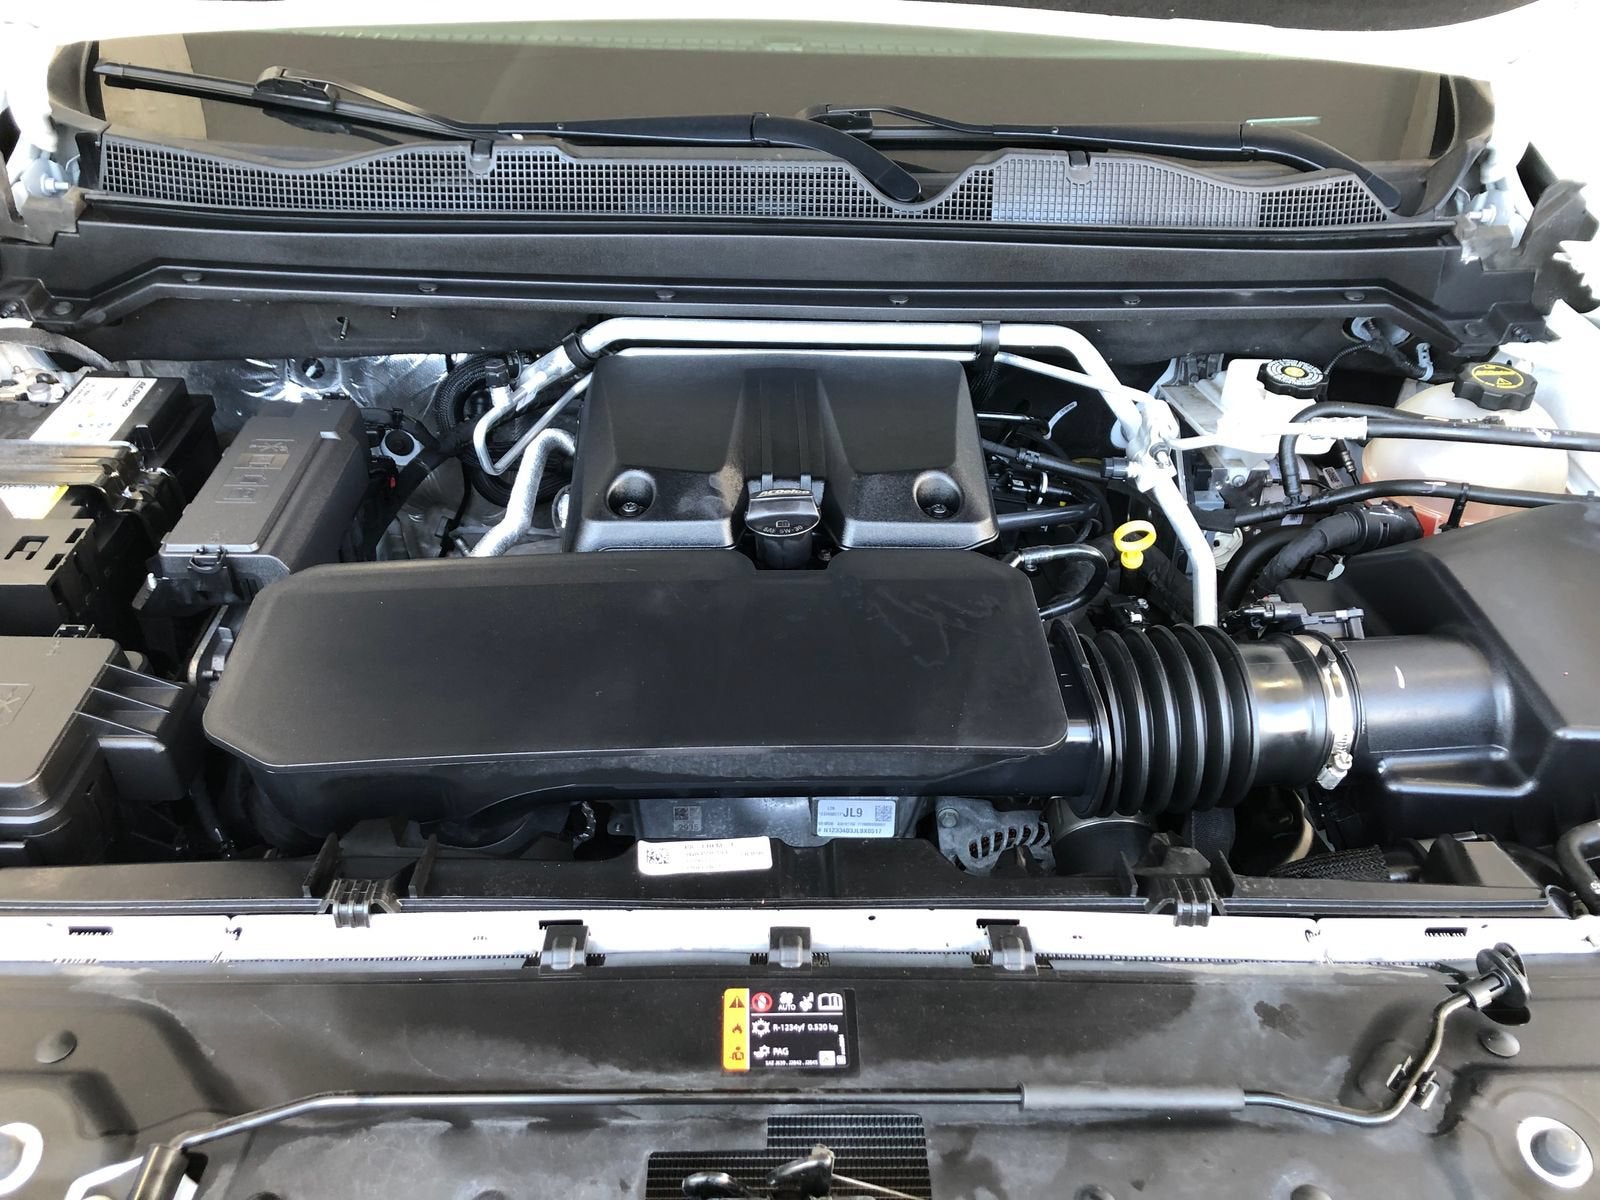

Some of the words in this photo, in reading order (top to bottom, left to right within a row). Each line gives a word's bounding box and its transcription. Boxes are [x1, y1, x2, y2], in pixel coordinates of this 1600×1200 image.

[756, 489, 810, 497] ACDelco
[763, 526, 776, 534] SAE
[779, 525, 803, 534] 5W-30
[843, 807, 863, 818] JL9
[778, 1003, 796, 1011] AUTO
[772, 1023, 806, 1033] R-1234yf
[807, 1023, 828, 1031] 0.520
[828, 1023, 839, 1033] kg
[772, 1047, 790, 1056] PAG
